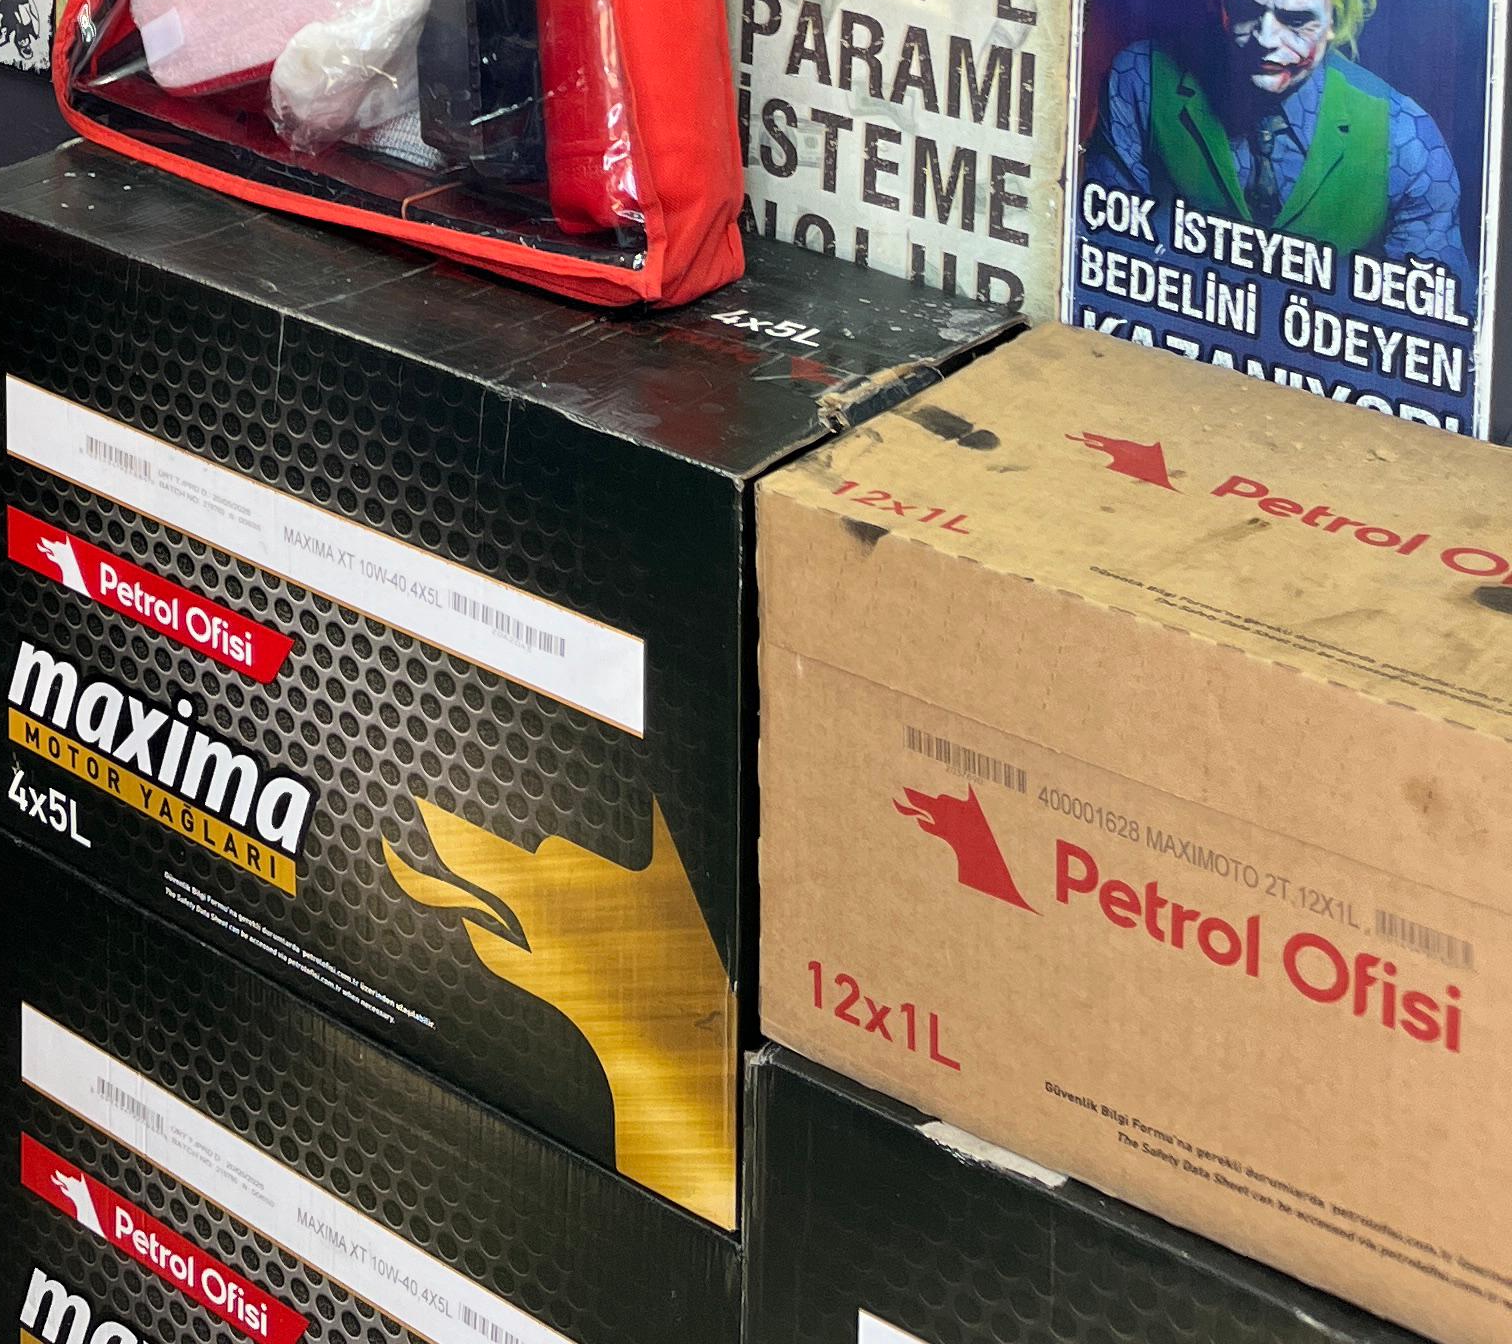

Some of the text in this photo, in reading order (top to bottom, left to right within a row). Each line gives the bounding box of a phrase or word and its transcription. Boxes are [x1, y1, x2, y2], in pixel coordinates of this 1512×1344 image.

[739, 71, 1032, 248] İSTEME
[1082, 183, 1469, 327] ÇOK İSTEYEN DEĞİL
[710, 309, 821, 348] 4x5L
[1080, 238, 1463, 393] BEDELİNİ ÖDEYEN
[283, 525, 334, 562] MAXIMA
[337, 551, 355, 569] XT
[831, 480, 973, 536] 12x1L
[1211, 474, 1429, 557] Petrol
[99, 561, 253, 667] Petrol Ofisi
[8, 640, 312, 855] maxima
[24, 721, 277, 880] MOTOR YAĞLARI
[8, 768, 92, 849] 4x5L
[1037, 784, 1260, 890] 400001628 MAXIMOTO
[1056, 839, 1462, 1053] Petrol Ofisi
[807, 960, 962, 1072] 12x1L
[1045, 1081, 1098, 1113] Güvenlik
[115, 1205, 195, 1288] Petrol
[201, 1267, 269, 1338] Ofisi
[296, 1206, 348, 1249] MAXIMA
[349, 1239, 369, 1265] XT
